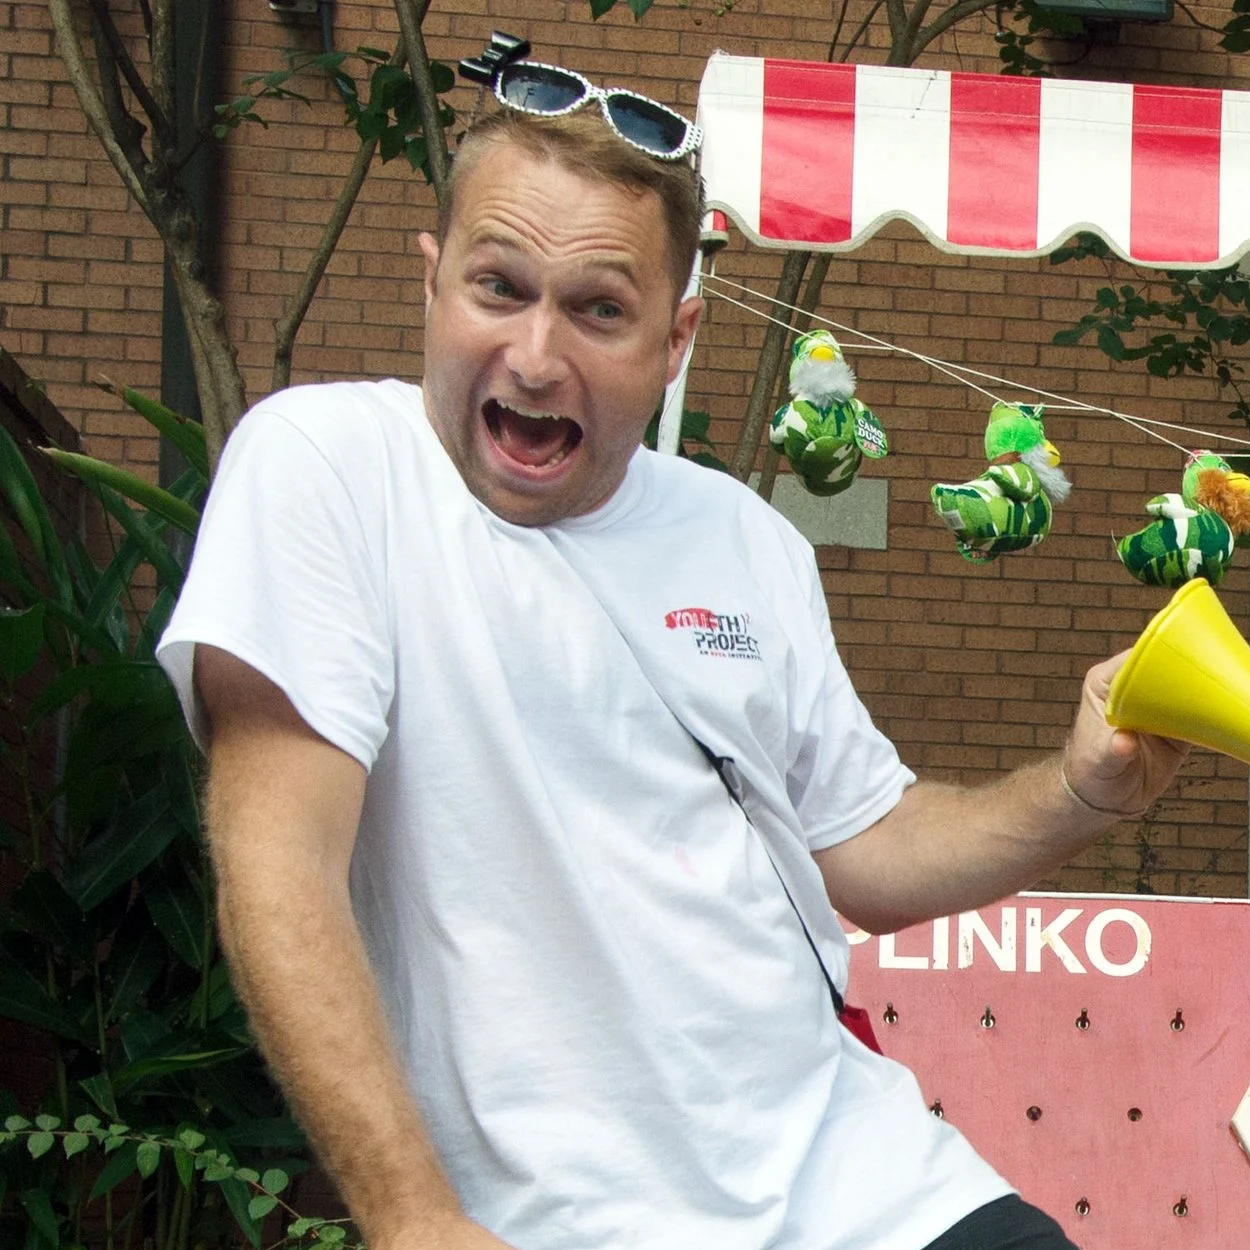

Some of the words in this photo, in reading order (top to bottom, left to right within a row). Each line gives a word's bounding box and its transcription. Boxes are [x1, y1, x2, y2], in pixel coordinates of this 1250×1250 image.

[858, 419, 883, 439] CAMO
[858, 428, 885, 448] DUCK
[846, 907, 1152, 977] LINKO
